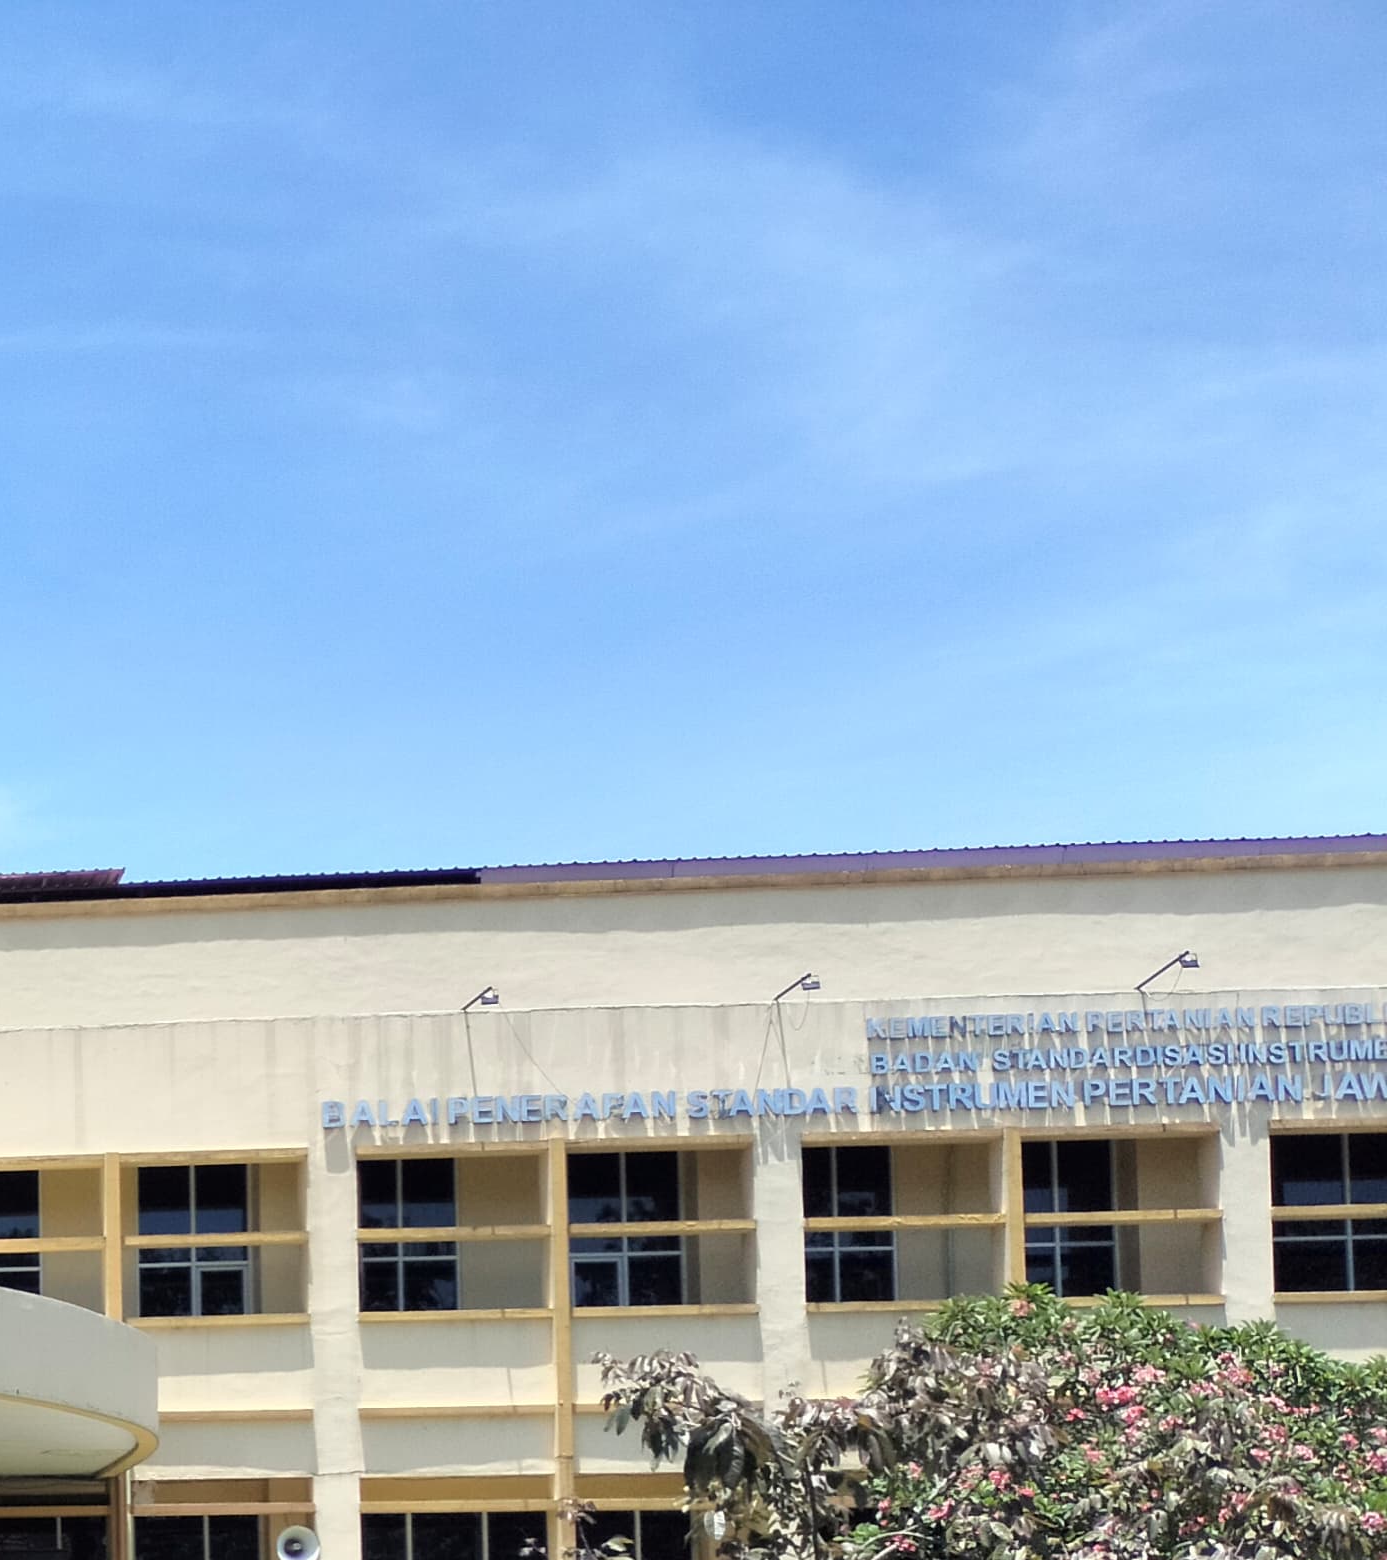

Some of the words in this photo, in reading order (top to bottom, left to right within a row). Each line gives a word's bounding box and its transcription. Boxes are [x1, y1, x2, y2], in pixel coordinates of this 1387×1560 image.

[867, 1011, 1079, 1040] KEMENTERIAN
[1085, 1007, 1255, 1033] PERTANIAN
[870, 1050, 979, 1075] BADAN
[992, 1042, 1234, 1071] STANDARDISASI
[322, 1097, 439, 1128] BALAI
[447, 1090, 676, 1125] PENERAPAN
[687, 1086, 859, 1119] STANDAR
[870, 1080, 1076, 1114] INSTRUMEN
[1082, 1073, 1302, 1107] PERTANIAN
